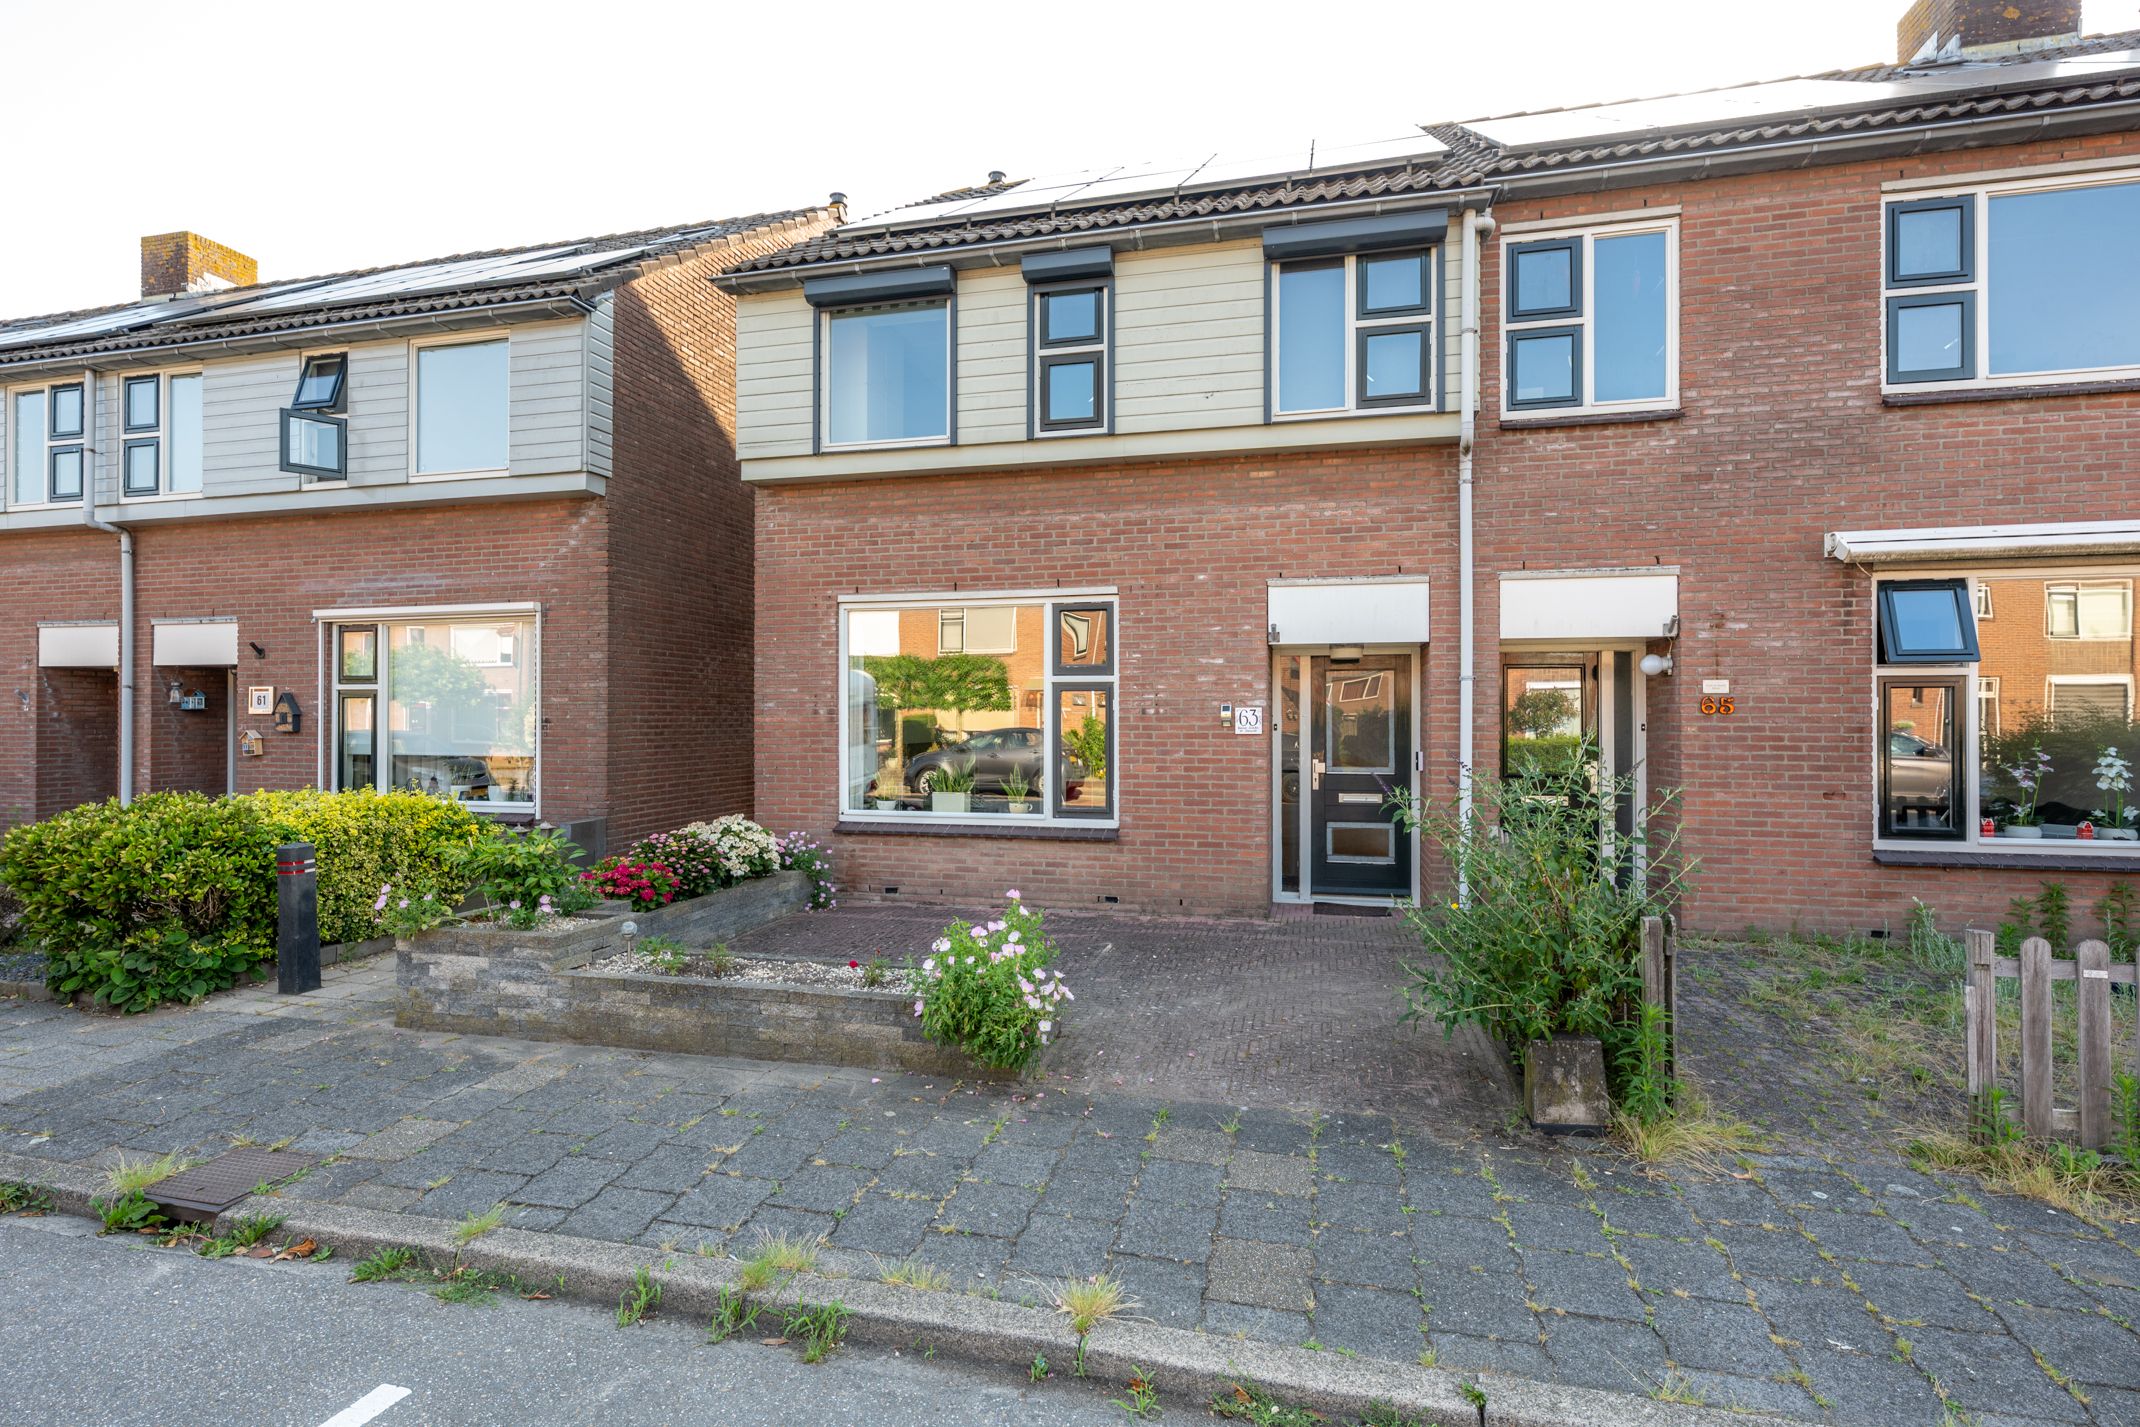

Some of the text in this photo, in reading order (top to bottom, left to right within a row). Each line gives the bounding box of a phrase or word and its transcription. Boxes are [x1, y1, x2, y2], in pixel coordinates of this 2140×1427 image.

[256, 695, 266, 706] 61
[1701, 696, 1735, 715] 65
[1239, 709, 1259, 727] 63
